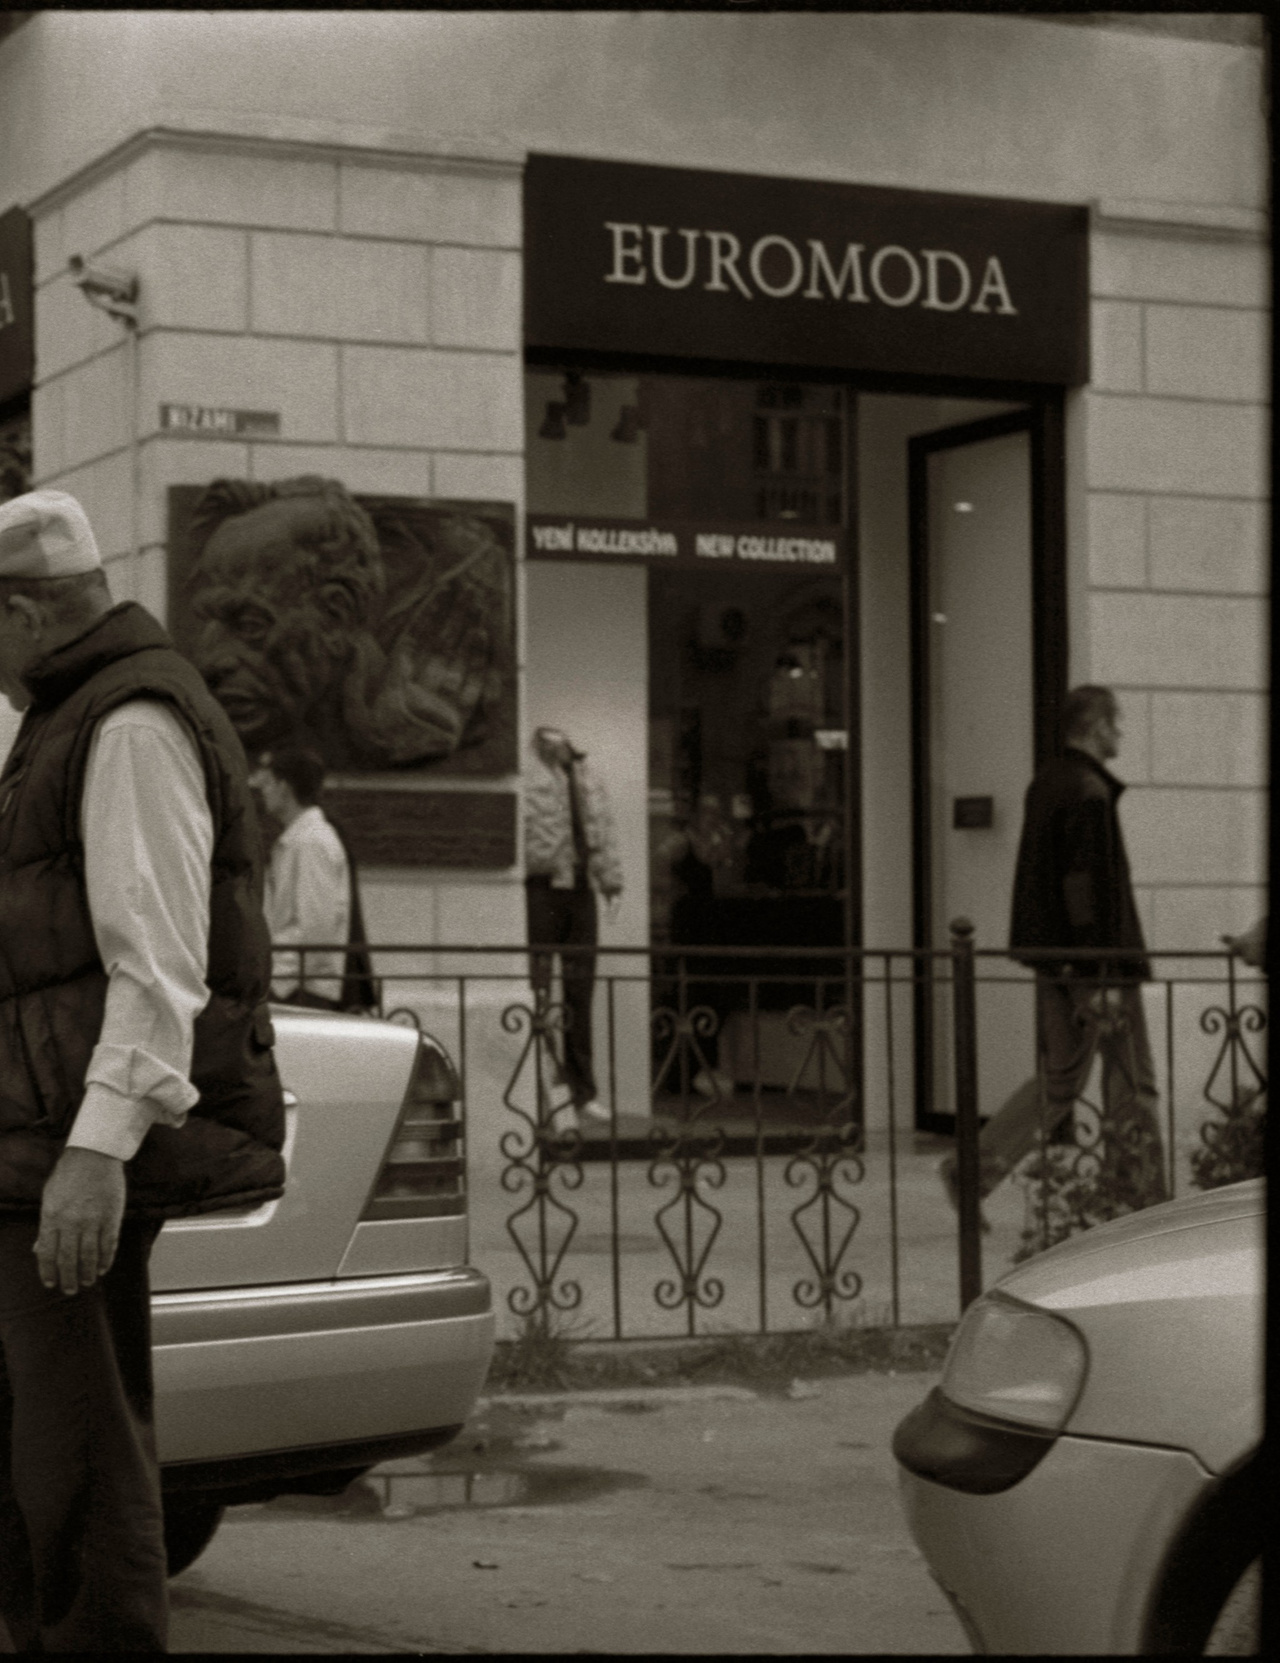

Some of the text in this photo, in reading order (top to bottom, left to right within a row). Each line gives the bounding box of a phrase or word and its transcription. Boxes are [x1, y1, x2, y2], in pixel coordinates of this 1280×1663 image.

[604, 220, 1018, 315] EUROMODA
[695, 533, 735, 557] NEW
[736, 534, 836, 563] COLLECTION
